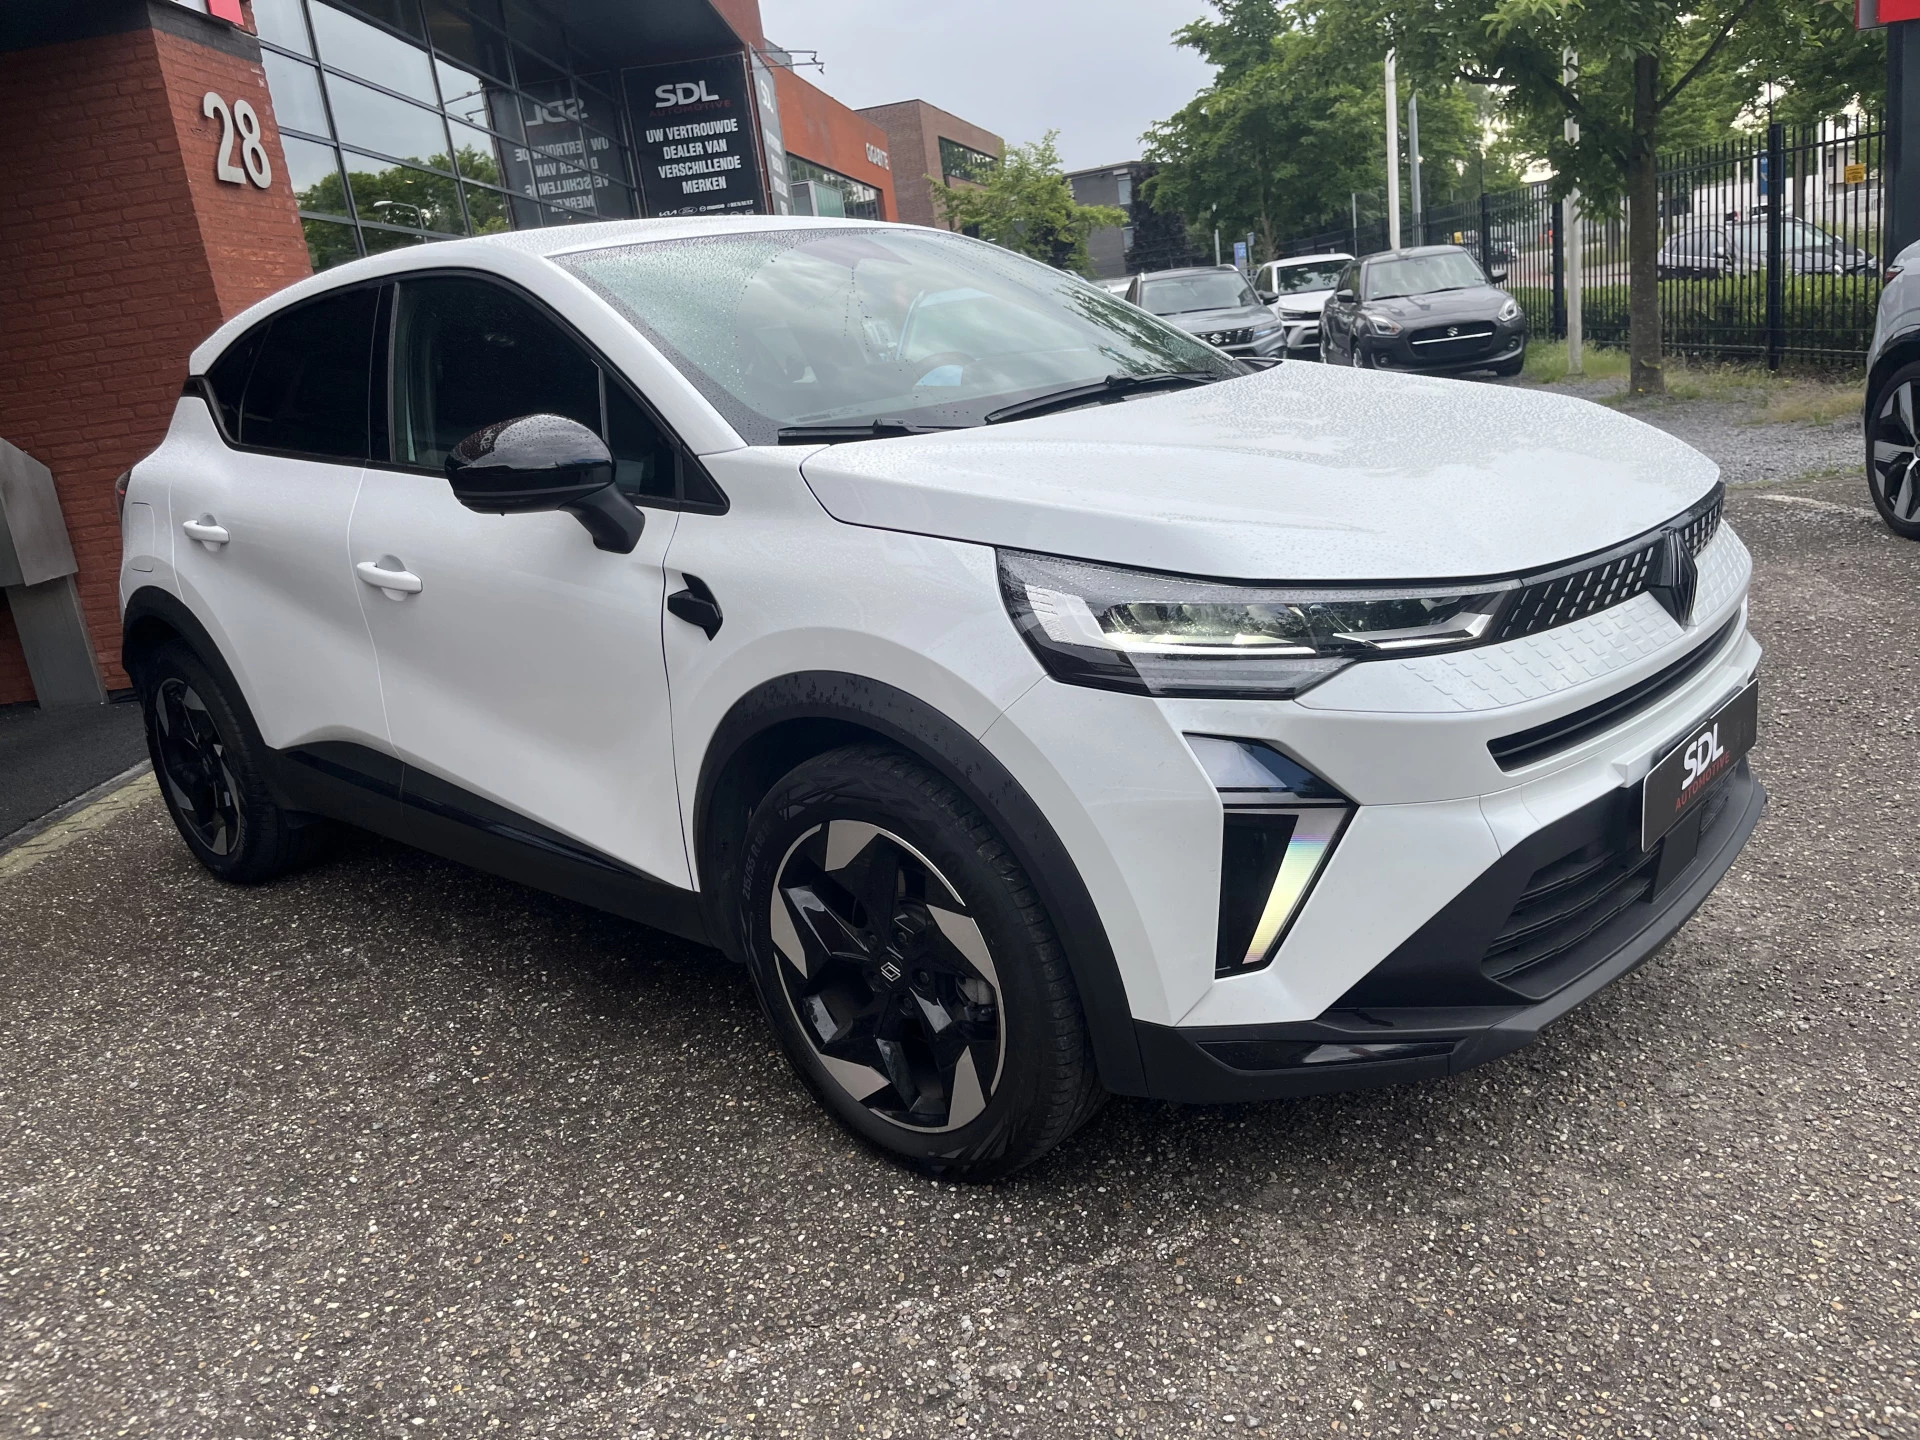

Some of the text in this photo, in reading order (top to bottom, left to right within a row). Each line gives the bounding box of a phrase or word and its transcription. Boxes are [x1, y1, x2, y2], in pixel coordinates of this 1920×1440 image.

[655, 80, 719, 108] SDL
[649, 98, 733, 118] AUTOMOTIVE
[203, 92, 272, 189] 28
[646, 118, 738, 143] UW VERTROUWDE
[663, 139, 728, 160] DEALER VAN
[658, 155, 741, 179] VERSCHILLENDE
[682, 176, 726, 194] MERKEN
[1681, 722, 1724, 790] SDL
[1675, 751, 1731, 812] AUTOMOTIVE
